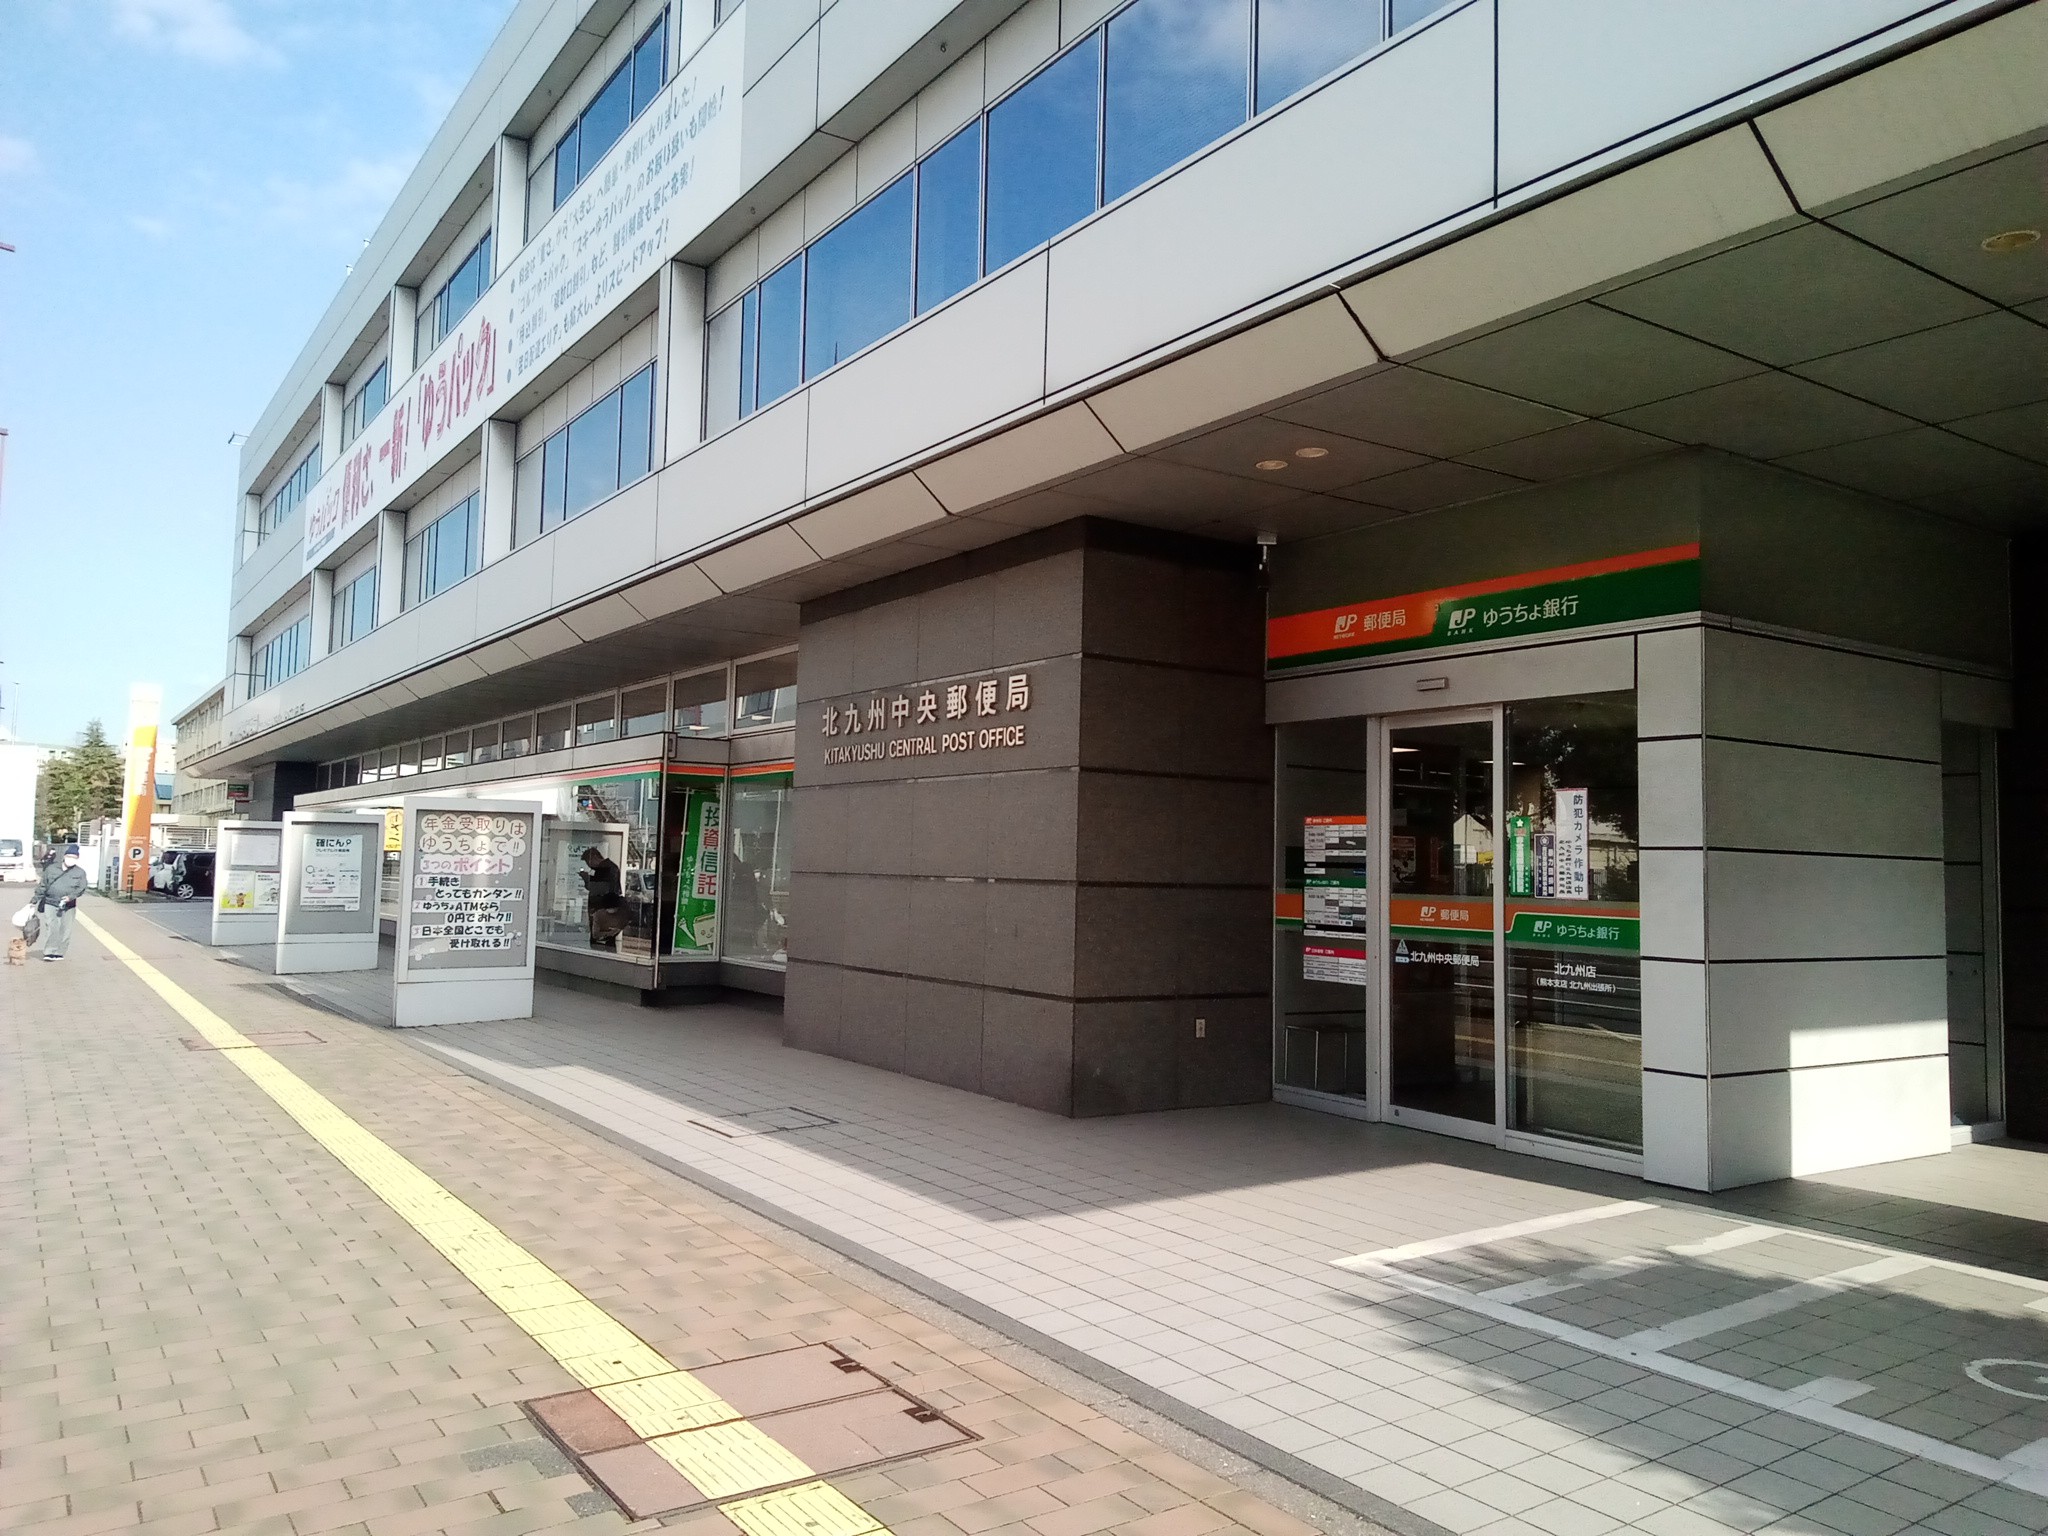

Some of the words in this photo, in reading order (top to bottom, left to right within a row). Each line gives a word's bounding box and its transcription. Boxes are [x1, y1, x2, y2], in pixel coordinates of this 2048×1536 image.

[1483, 595, 1579, 627] ゆうちょ銀行
[1363, 609, 1406, 632] 郵便局
[821, 673, 1030, 737] 北九州中央郵便局
[823, 741, 885, 765] KITAKYUSHU
[888, 735, 937, 758] CENTRAL
[941, 730, 976, 753] POST
[978, 724, 1026, 749] OFFICE
[424, 815, 525, 836] 年金受取りは
[132, 848, 142, 859] P
[697, 806, 720, 896] 投資信託
[1573, 794, 1584, 896] 防犯カメラ作動中
[423, 857, 511, 872] 3つのポイント
[428, 876, 460, 887] 手続き
[423, 901, 500, 911] ゆうちょATMなら
[1440, 909, 1469, 922] 郵便局
[422, 925, 504, 936] 日本全国どこでも
[1556, 924, 1620, 941] ゆうちょ銀行
[1410, 950, 1480, 967] 北九州中央郵便局
[1554, 962, 1597, 978] 北九州店
